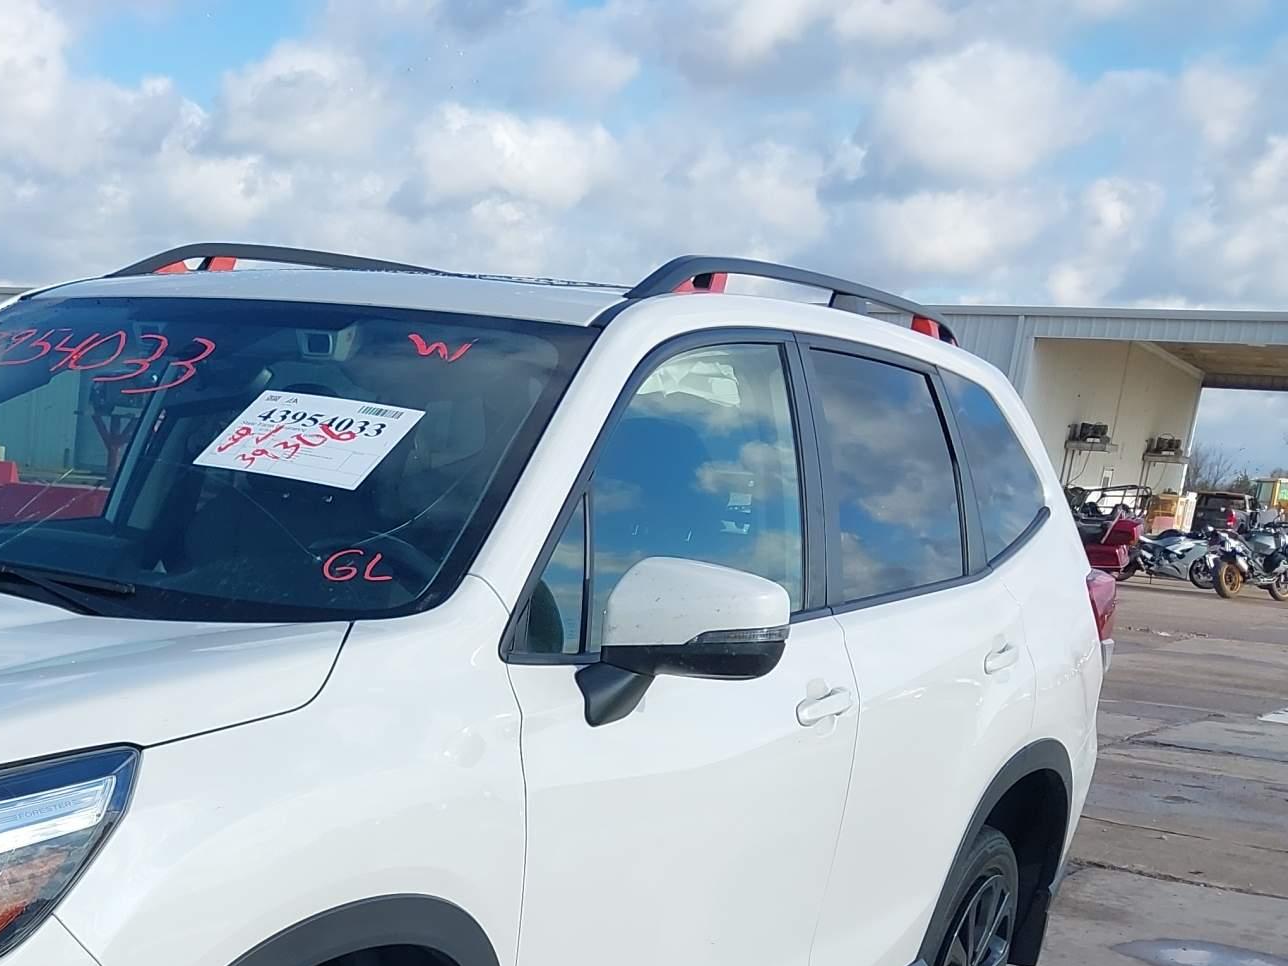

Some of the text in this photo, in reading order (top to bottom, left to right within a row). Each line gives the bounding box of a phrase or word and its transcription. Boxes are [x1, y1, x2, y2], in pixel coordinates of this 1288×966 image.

[257, 407, 387, 438] 43954033
[322, 548, 393, 582] GL
[18, 800, 72, 819] FORESTER
